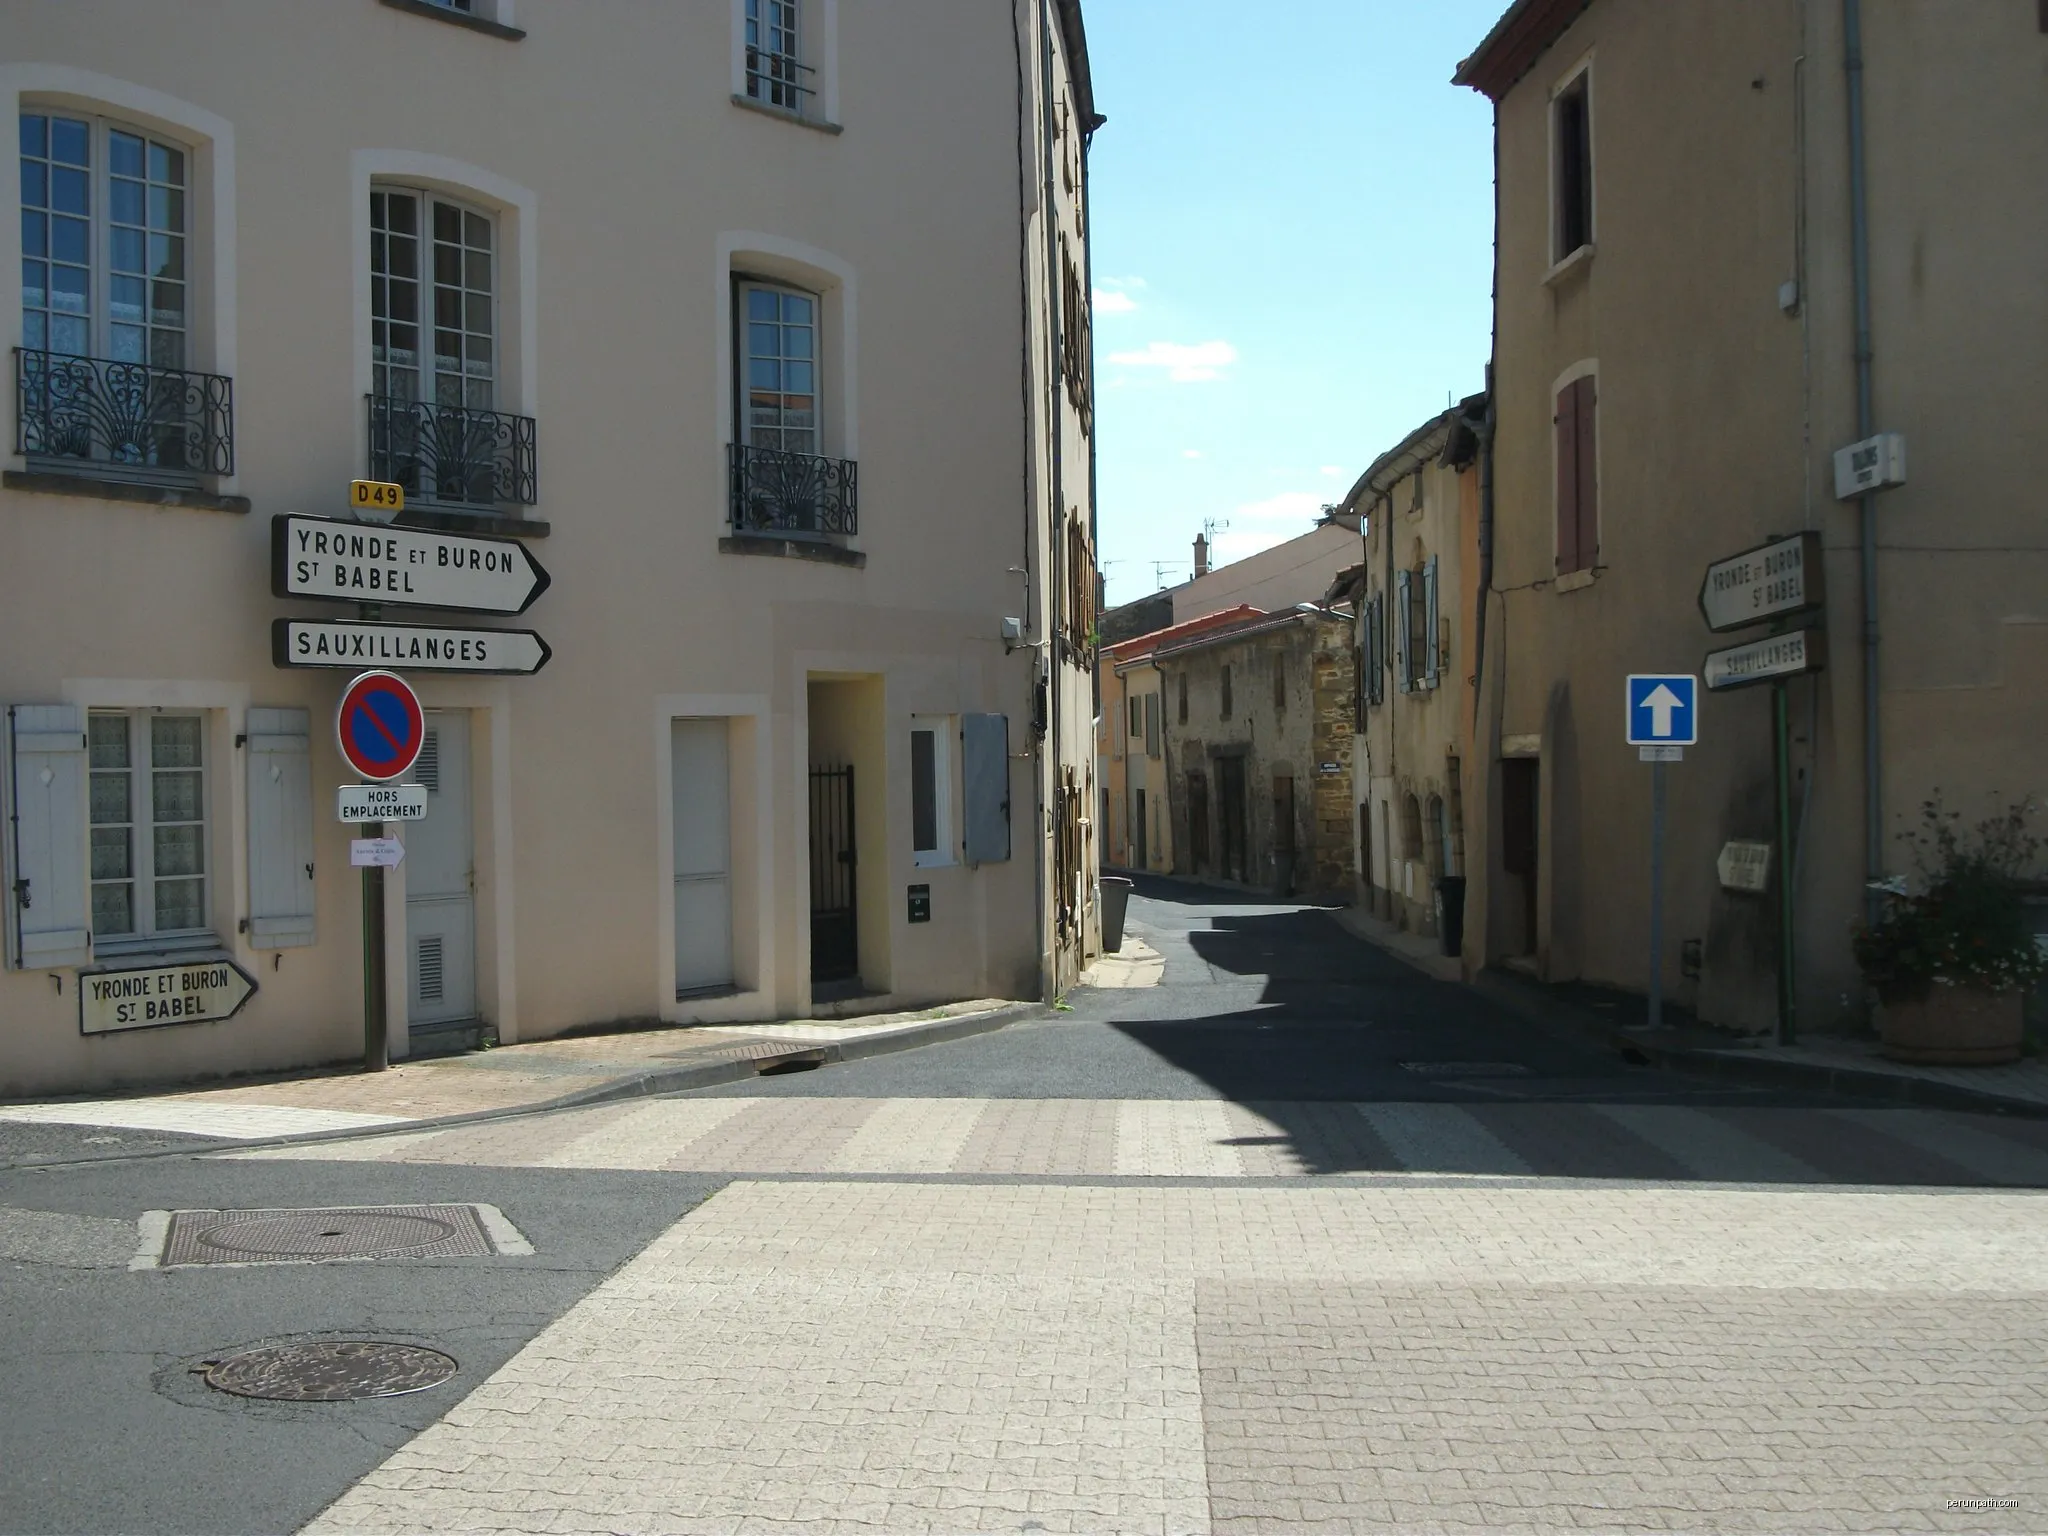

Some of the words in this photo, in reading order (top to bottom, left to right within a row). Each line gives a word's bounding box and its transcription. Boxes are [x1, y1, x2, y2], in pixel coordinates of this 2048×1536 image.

[297, 529, 397, 562] YRONDE
[409, 549, 426, 565] ET
[437, 545, 512, 574] BURON
[335, 564, 415, 593] BABEL
[1713, 563, 1751, 592] YRONDE
[1764, 547, 1802, 577] BURON
[1767, 576, 1802, 604] BABEL
[297, 631, 488, 662] SAUXILLANGES
[1726, 639, 1803, 676] SAUXILLANGES
[343, 804, 423, 819] EMPLACEMENT
[368, 790, 398, 803] HORS
[92, 976, 151, 1001] YRONDE
[158, 974, 175, 994] ET
[182, 968, 228, 991] BURON
[146, 996, 206, 1020] BABEL
